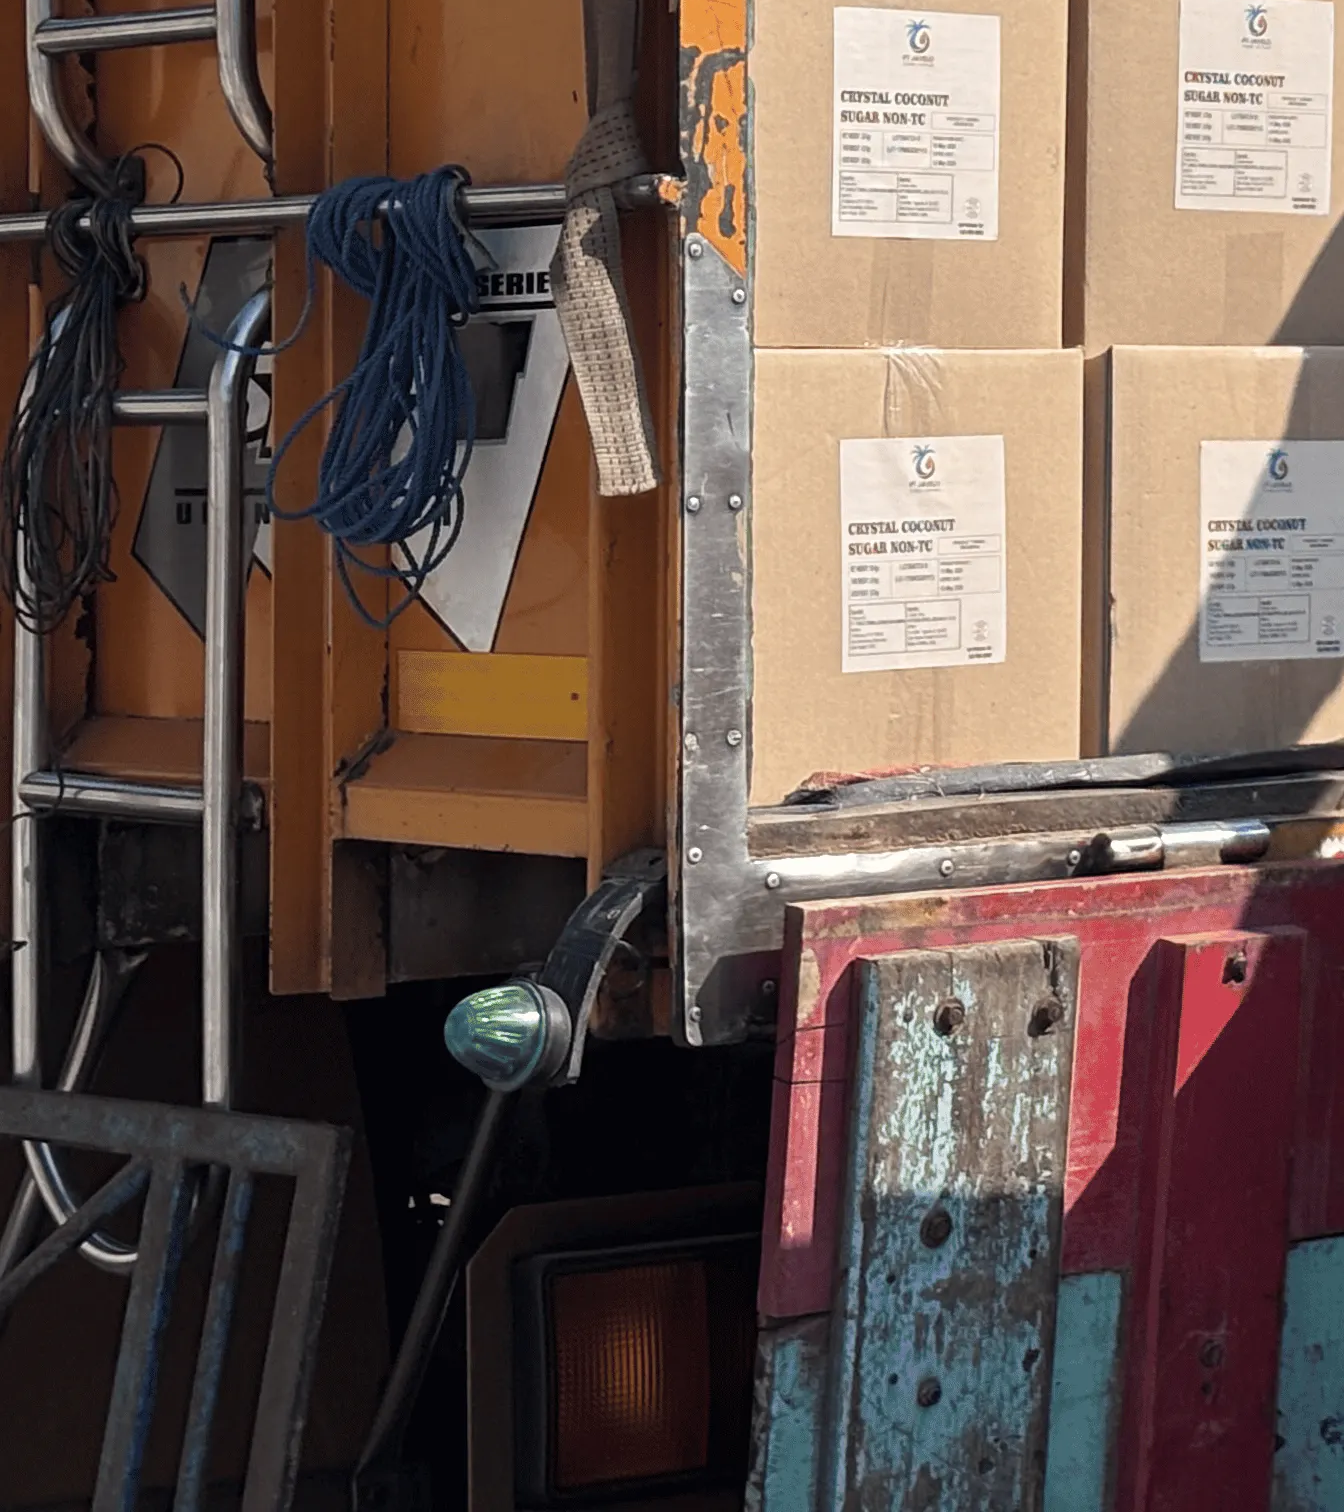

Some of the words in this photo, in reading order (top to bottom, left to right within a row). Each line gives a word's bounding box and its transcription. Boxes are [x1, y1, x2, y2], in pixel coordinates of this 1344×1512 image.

[1184, 71, 1231, 86] CRYSTAL
[1234, 73, 1285, 88] COCONUT
[840, 90, 891, 105] CRYSTAL
[895, 92, 949, 107] COCONUT
[1184, 90, 1220, 104] SUGAR
[1223, 91, 1263, 105] NON-TC
[840, 110, 880, 124] SUGAR
[883, 111, 926, 126] NON-TC
[475, 272, 549, 297] SERIE
[848, 520, 899, 536] CRYSTAL
[901, 518, 956, 534] COCONUT
[1208, 519, 1253, 532] CRYSTAL
[1257, 518, 1307, 531] COCONUT
[848, 541, 888, 556] SUGAR
[890, 539, 933, 554] NON-TC
[1207, 539, 1244, 552] SUGAR
